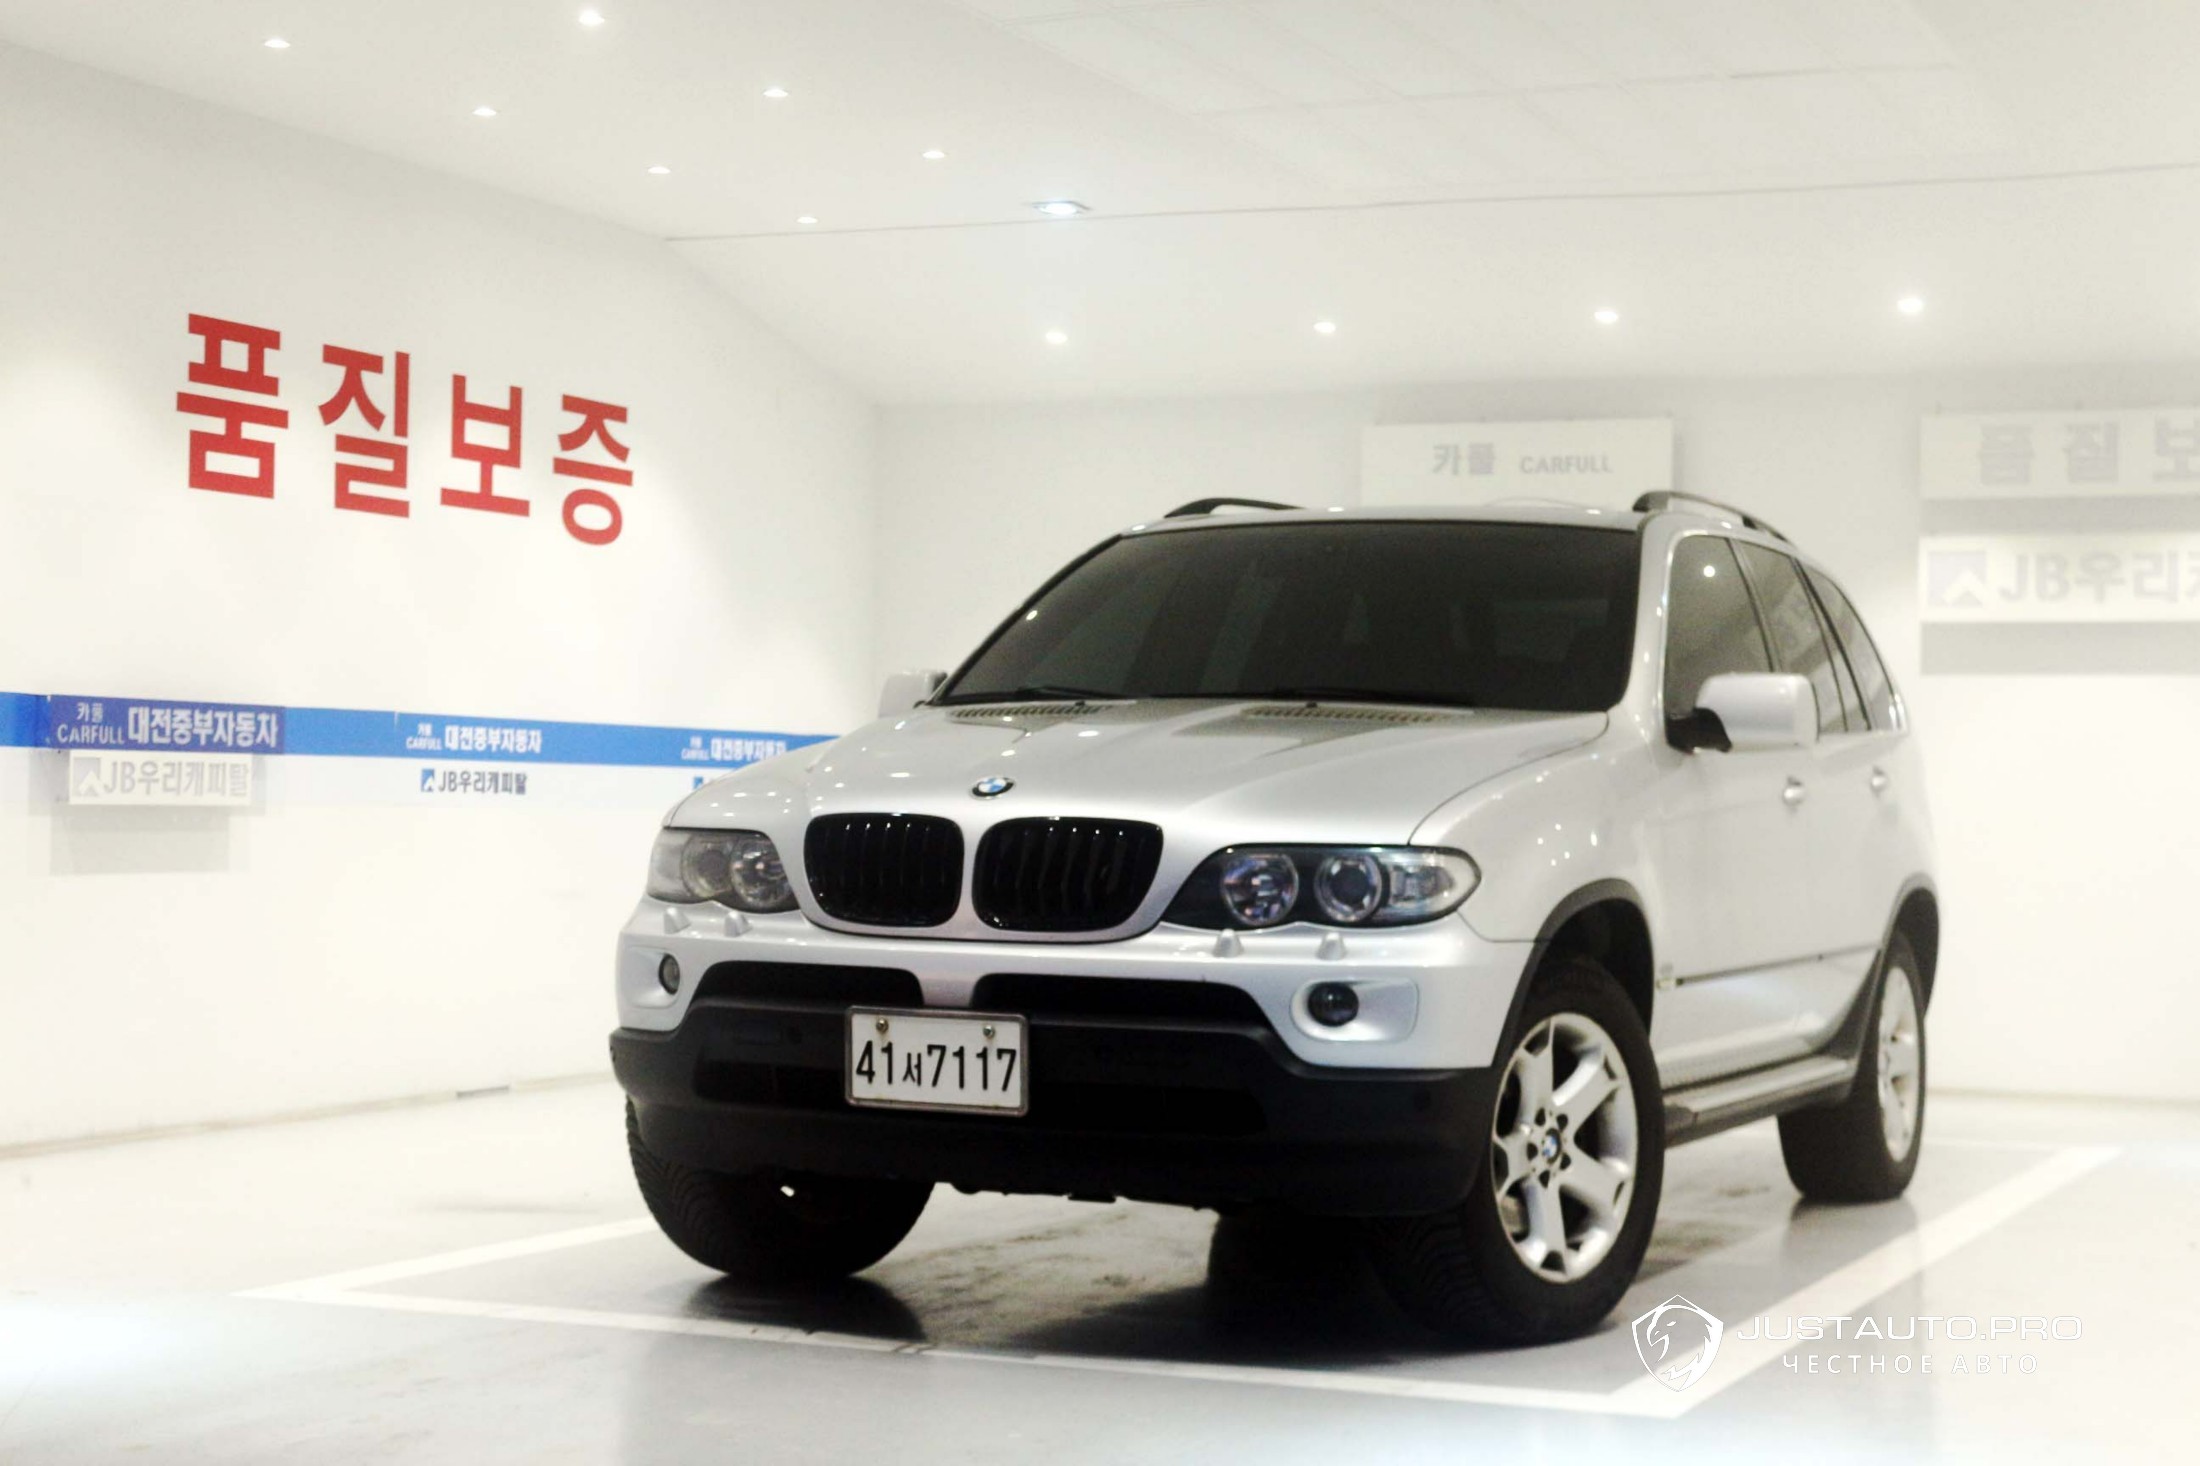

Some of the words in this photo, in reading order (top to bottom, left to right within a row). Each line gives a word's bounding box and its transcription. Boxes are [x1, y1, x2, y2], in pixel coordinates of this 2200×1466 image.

[176, 313, 634, 545] 품질보증
[1519, 454, 1614, 475] CARFULL
[57, 723, 125, 745] CARFULL
[127, 706, 279, 748] 대전중부자동차
